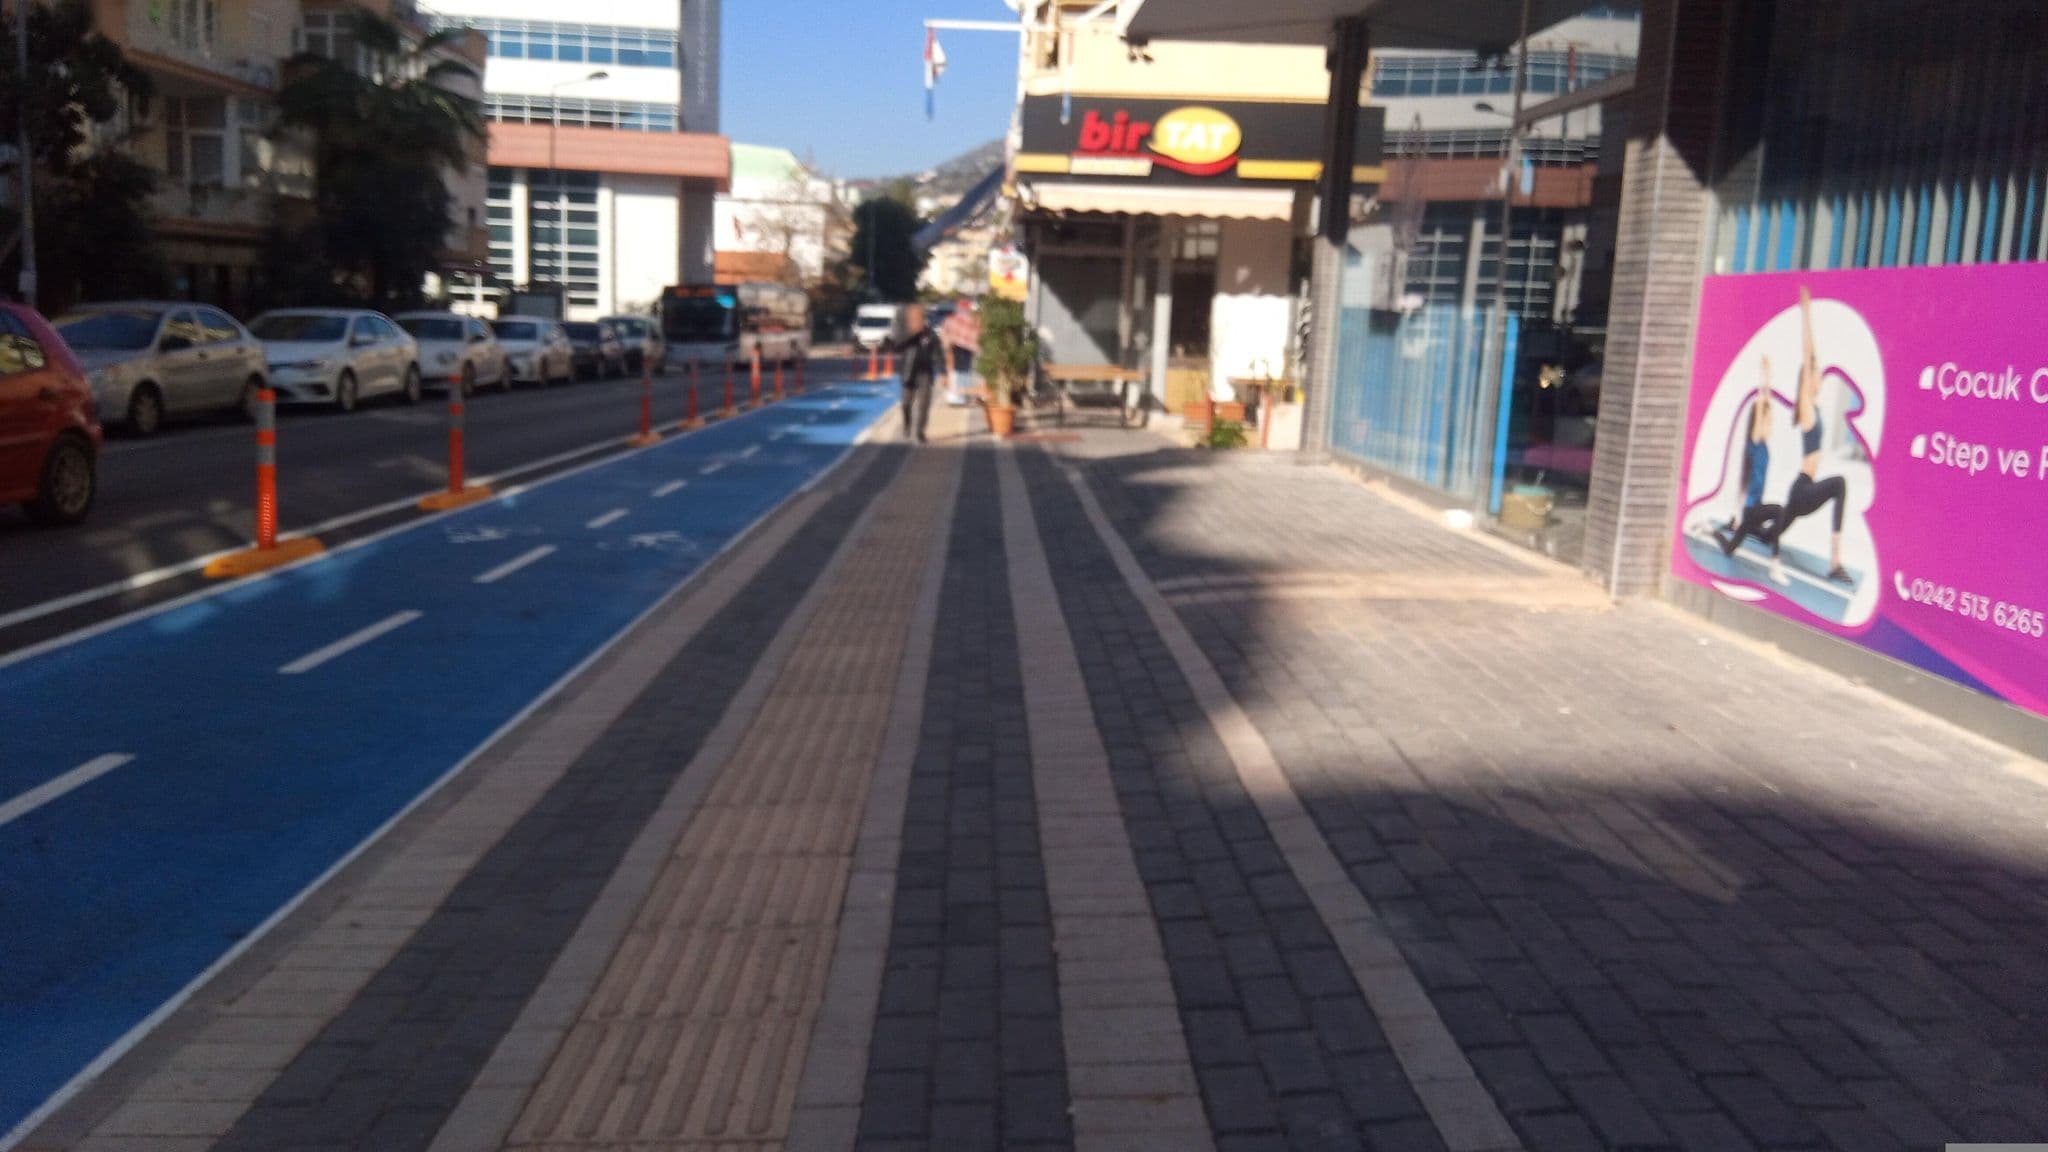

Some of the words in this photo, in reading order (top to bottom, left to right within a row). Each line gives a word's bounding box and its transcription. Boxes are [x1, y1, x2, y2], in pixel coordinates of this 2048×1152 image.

[1079, 110, 1150, 151] bir
[1165, 121, 1232, 150] TAT
[1937, 361, 2022, 401] Çocuk
[1929, 431, 1989, 477] Step
[1998, 447, 2030, 478] ve
[1911, 577, 1955, 612] 0242
[1959, 591, 1990, 621] 513
[1993, 601, 2045, 638] 6265
